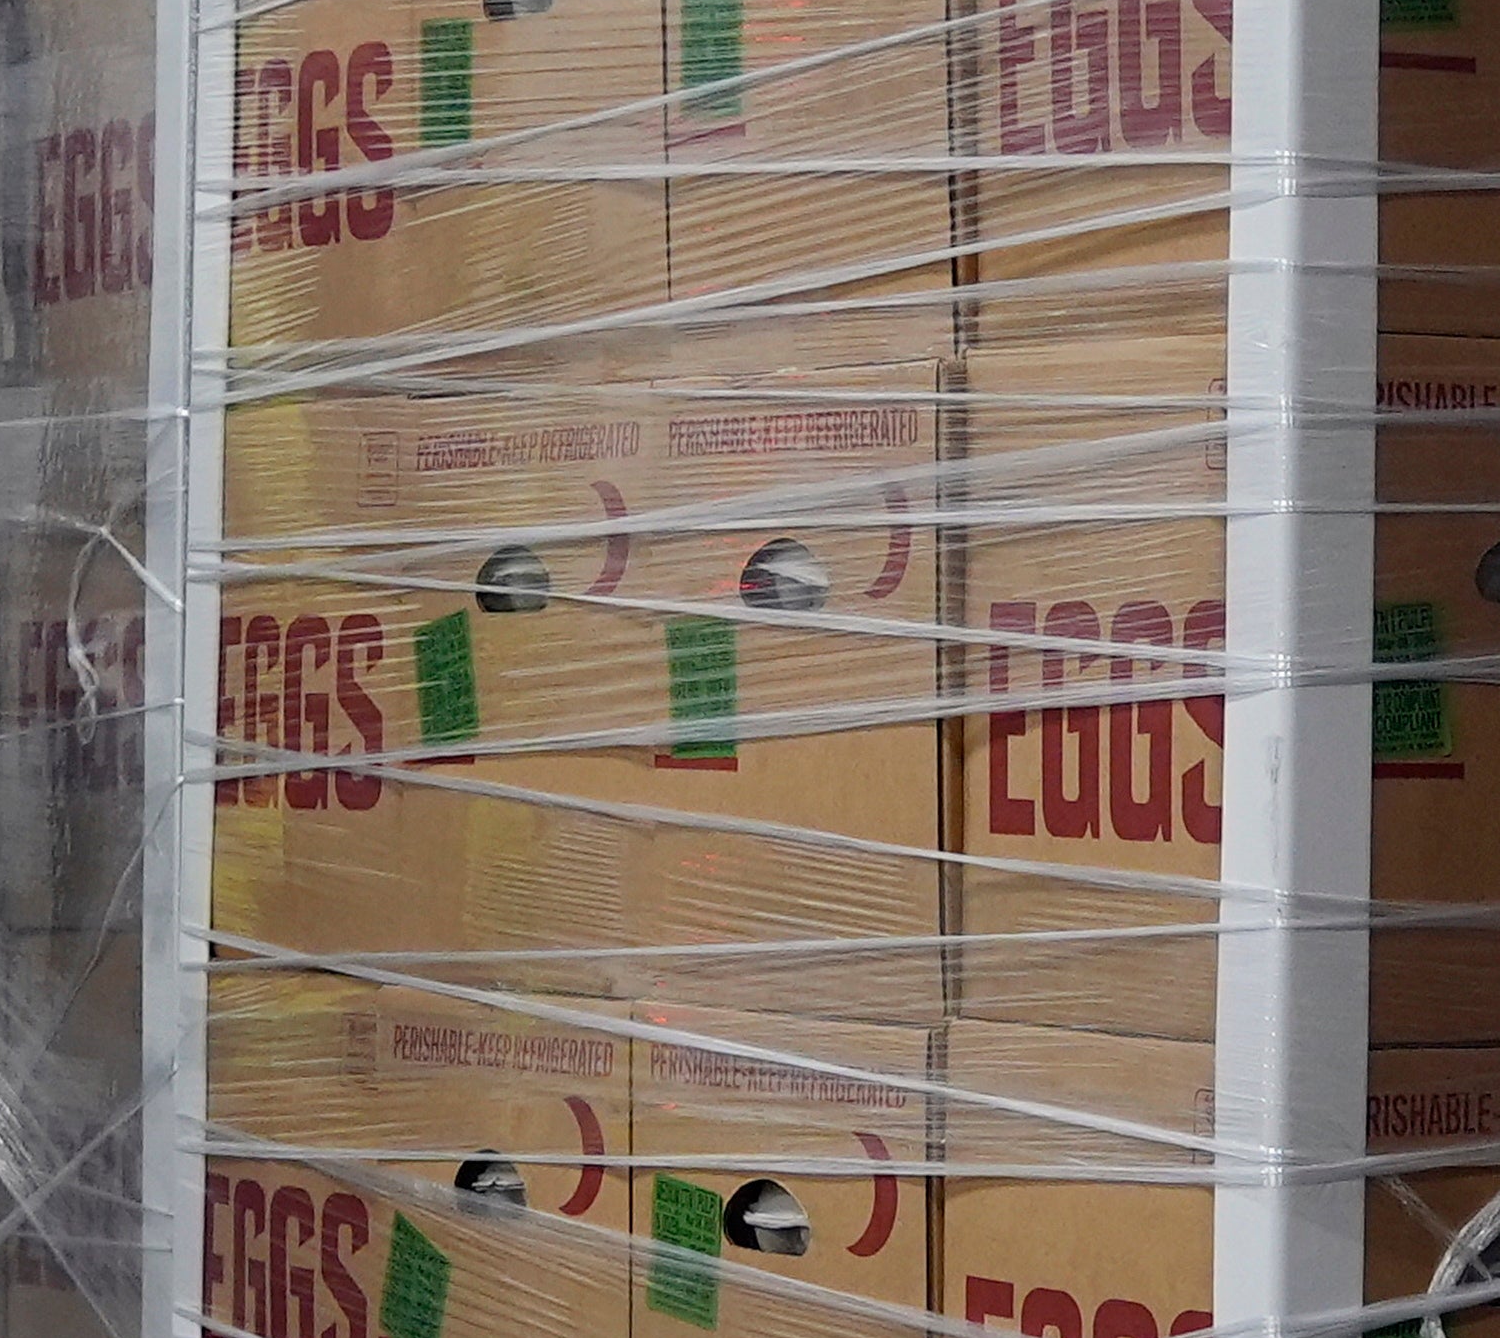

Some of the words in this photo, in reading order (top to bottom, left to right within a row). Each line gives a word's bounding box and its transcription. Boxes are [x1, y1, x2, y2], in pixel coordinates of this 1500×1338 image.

[33, 109, 157, 306] EGGS
[216, 613, 384, 811] EGGS
[988, 600, 1226, 844] EGGS
